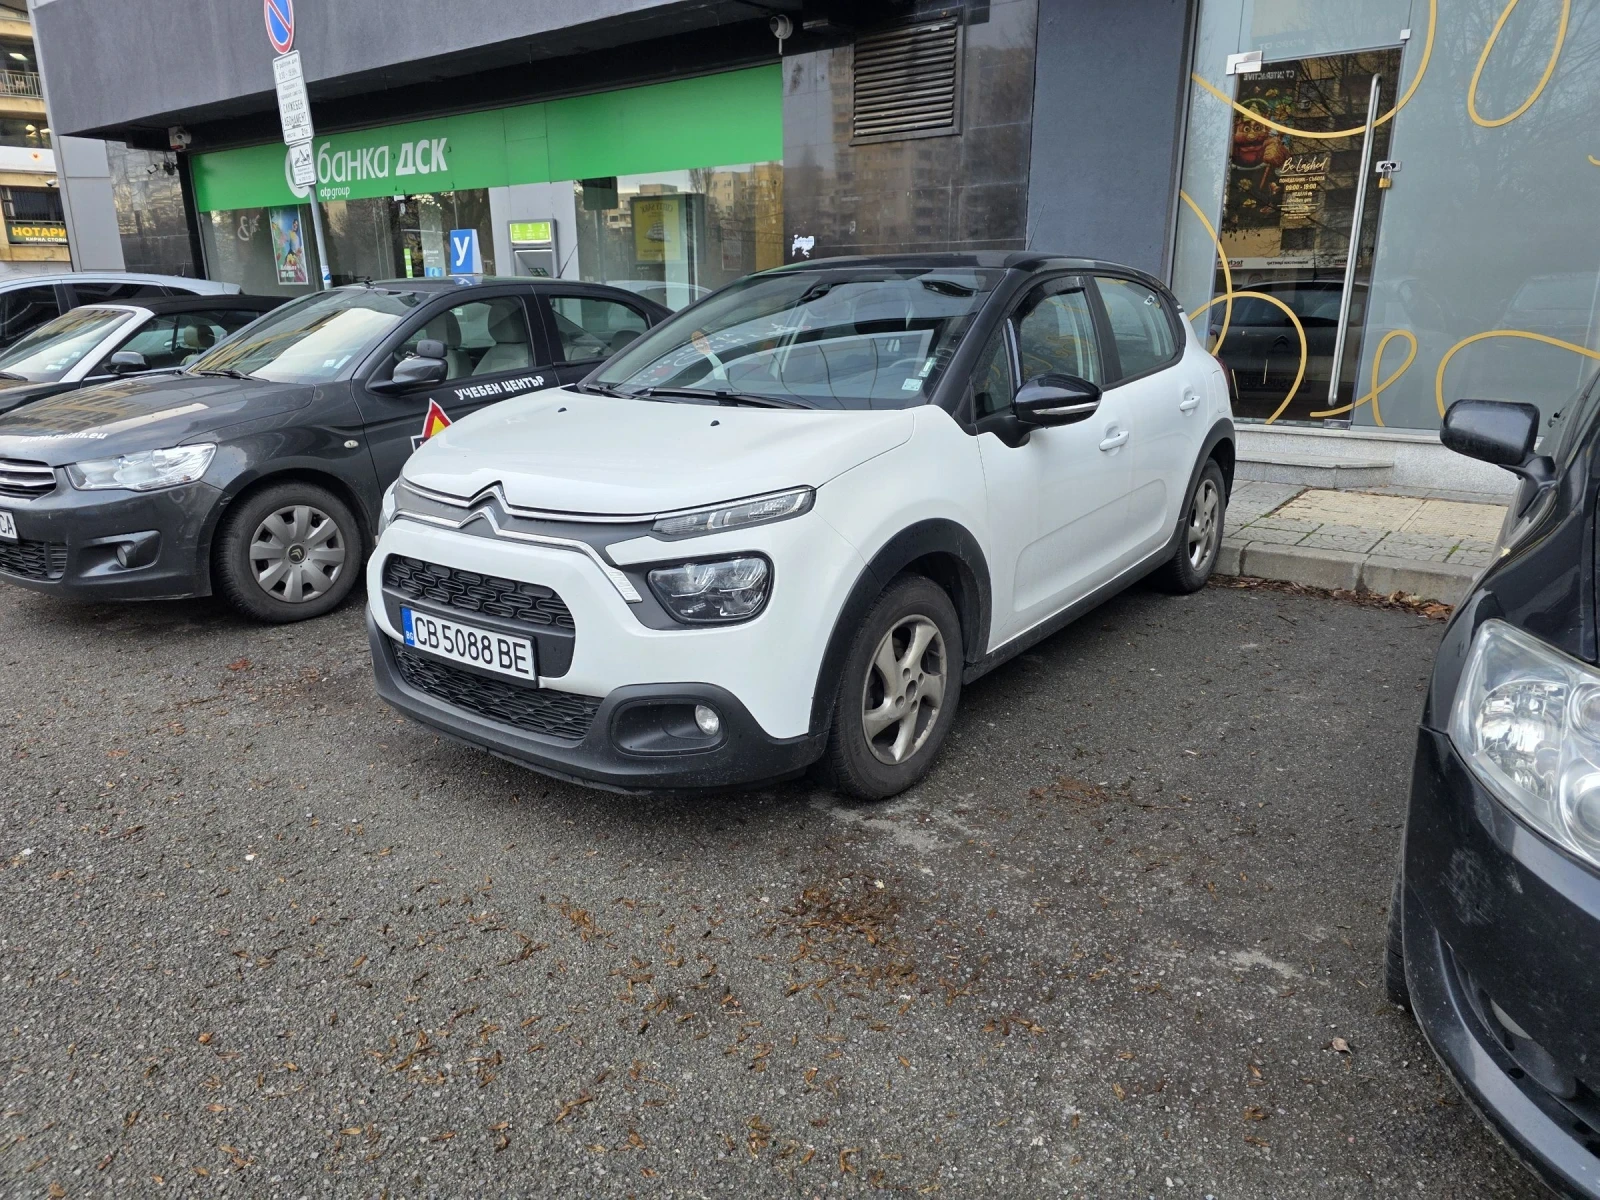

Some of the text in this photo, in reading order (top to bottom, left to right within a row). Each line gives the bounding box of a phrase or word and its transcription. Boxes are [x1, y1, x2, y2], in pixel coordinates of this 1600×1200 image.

[318, 137, 448, 184] банка ДСК
[1280, 156, 1328, 174] Be Lashed
[454, 375, 545, 400] УЧЕБЕН ЦЕНТЪР
[406, 630, 414, 641] BG
[415, 616, 529, 674] CB 5088 BE
